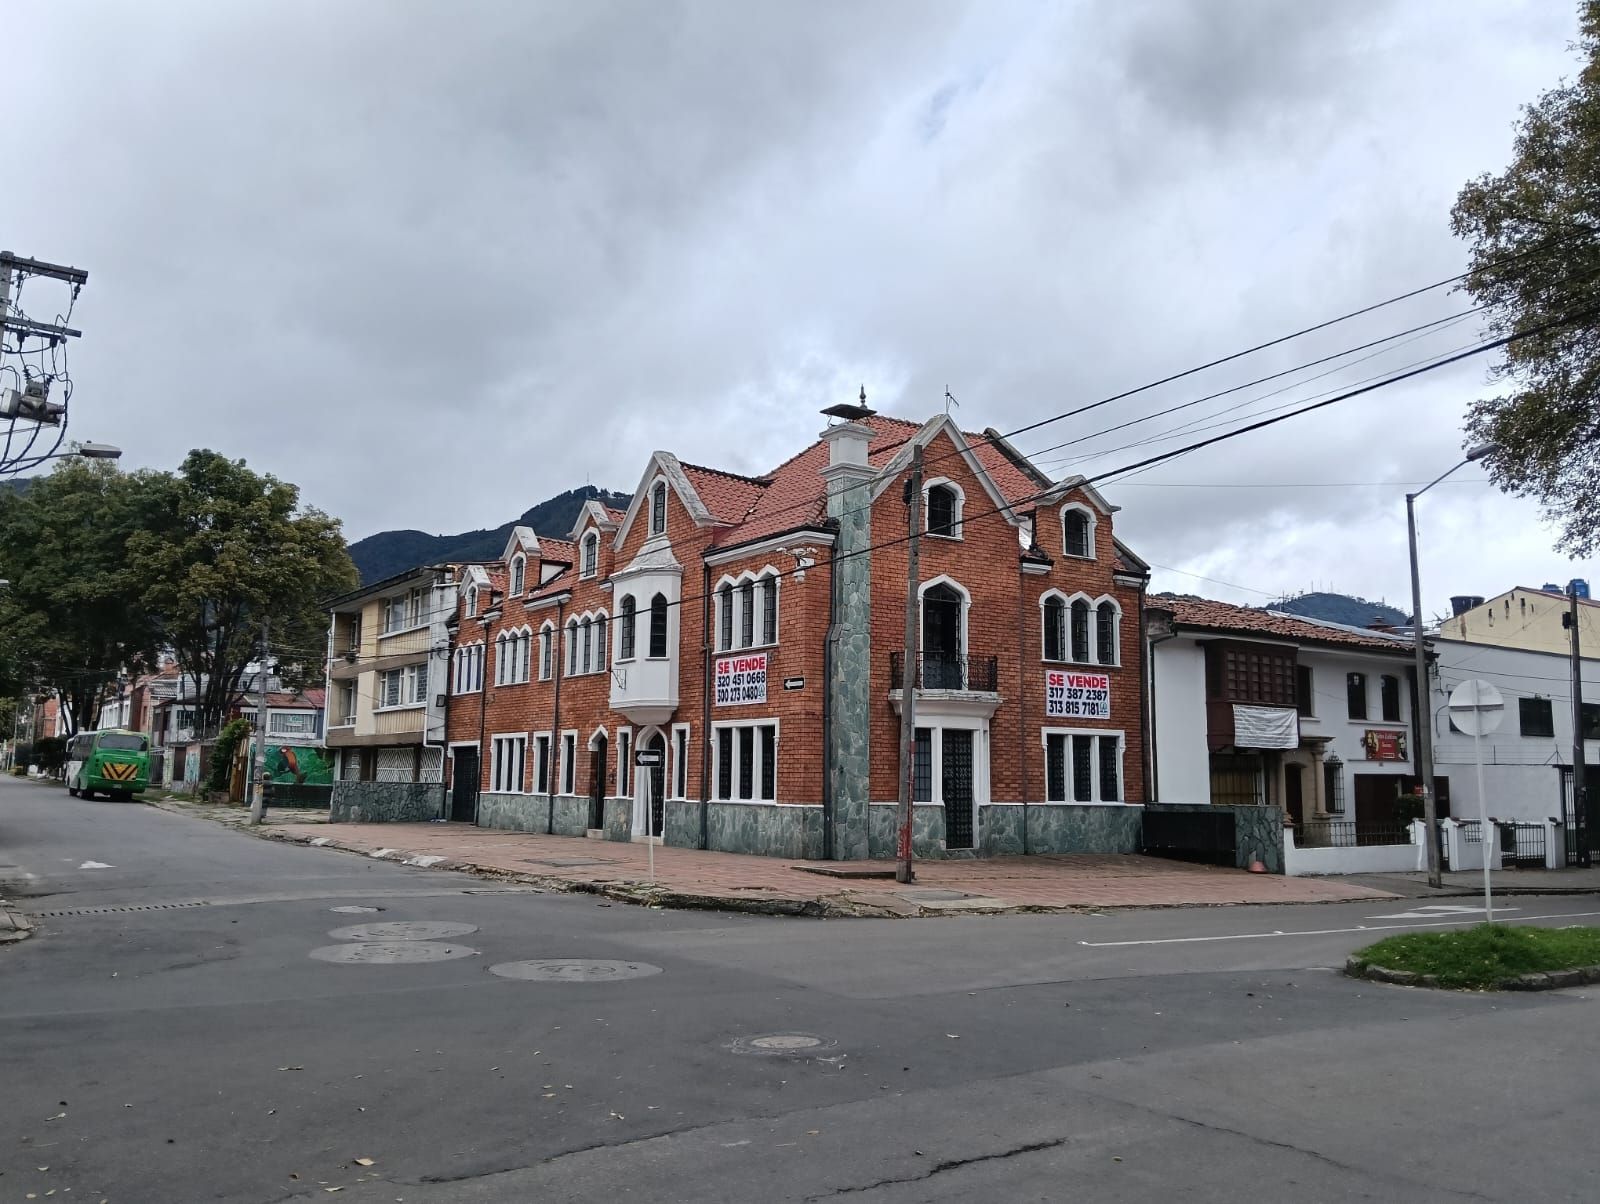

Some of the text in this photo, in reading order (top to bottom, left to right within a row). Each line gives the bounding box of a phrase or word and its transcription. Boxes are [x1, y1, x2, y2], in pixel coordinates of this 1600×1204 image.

[718, 657, 765, 674] SE VENDE
[717, 671, 765, 687] 320 451 0668
[1049, 673, 1107, 689] SE VENDE
[717, 689, 729, 703] 300
[730, 687, 741, 701] 273
[1049, 687, 1107, 701] 317 387 2387
[1049, 700, 1100, 715] 313 815 7181
